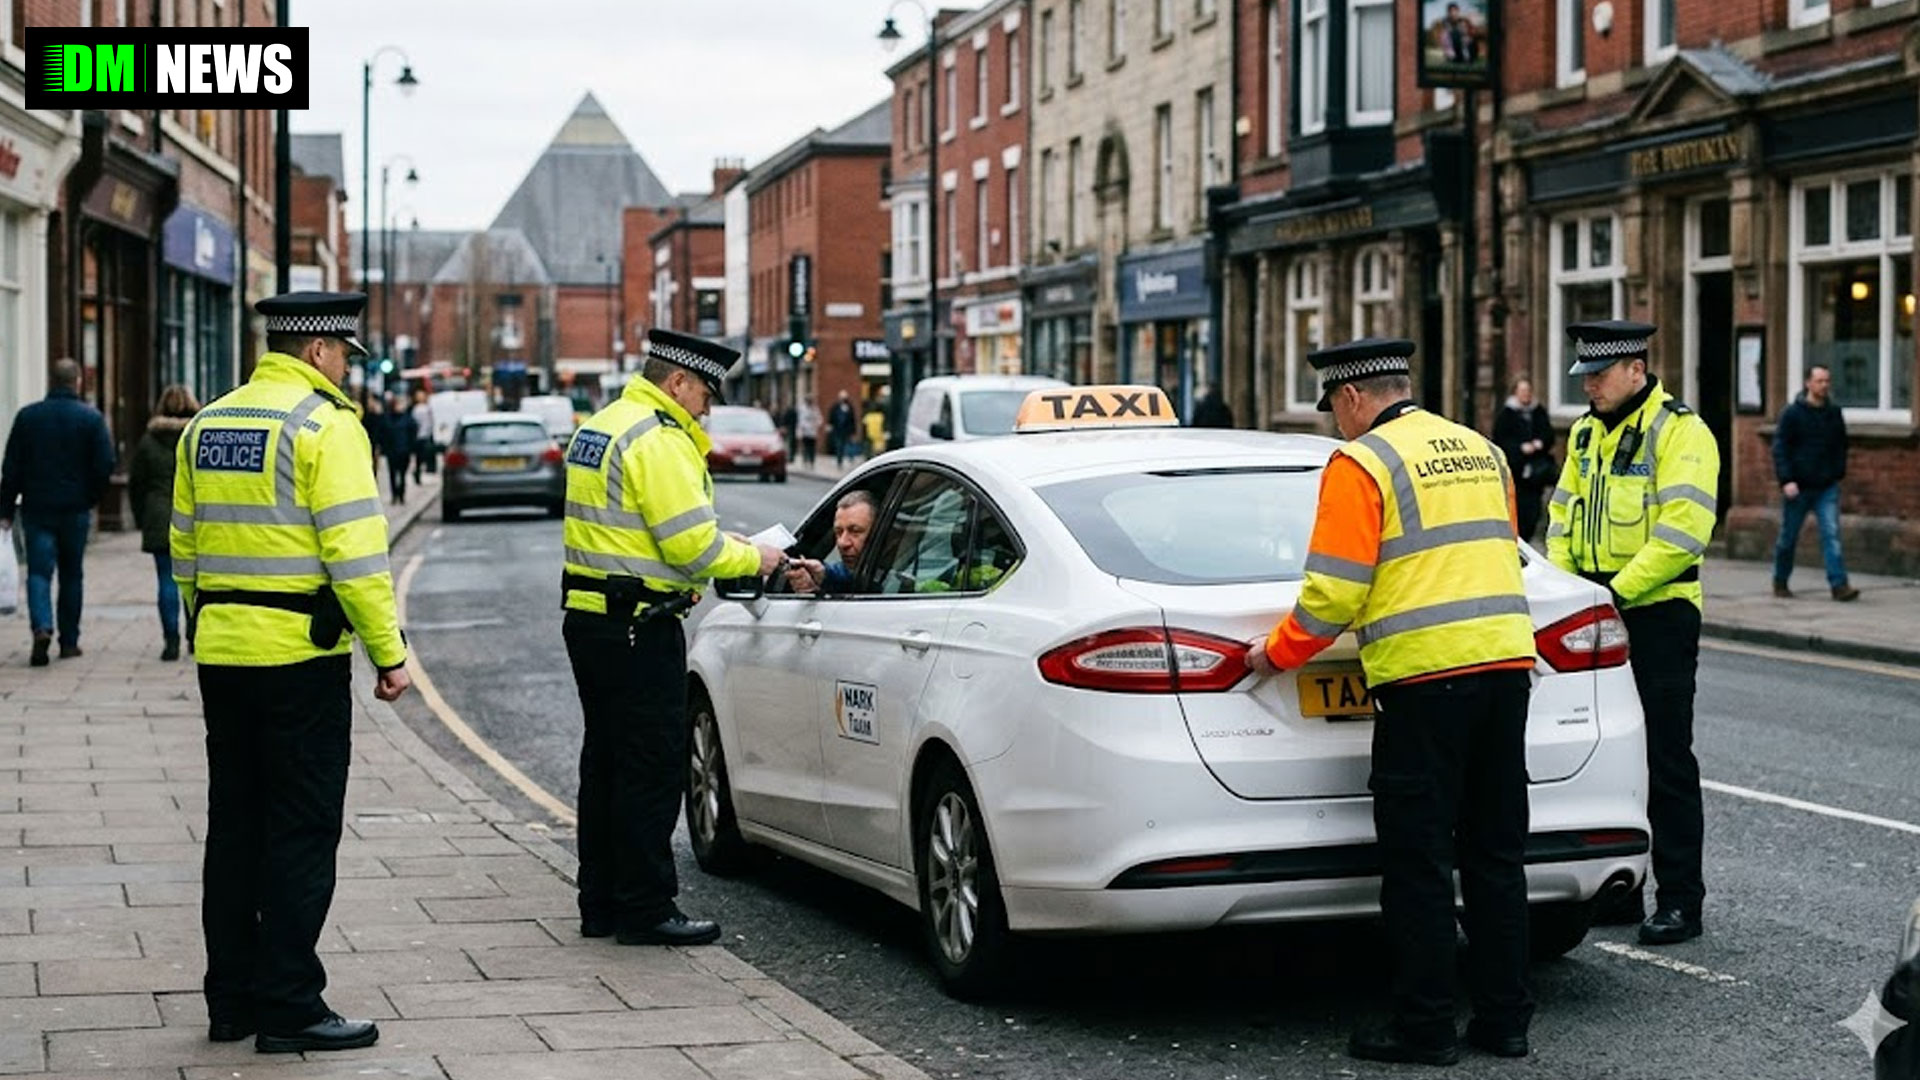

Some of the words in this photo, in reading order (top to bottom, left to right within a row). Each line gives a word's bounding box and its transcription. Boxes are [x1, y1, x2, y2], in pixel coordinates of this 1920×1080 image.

[1041, 392, 1161, 420] TAXI
[197, 444, 263, 468] POLICE
[1427, 437, 1468, 454] TAXI
[1414, 455, 1496, 478] LICENSING
